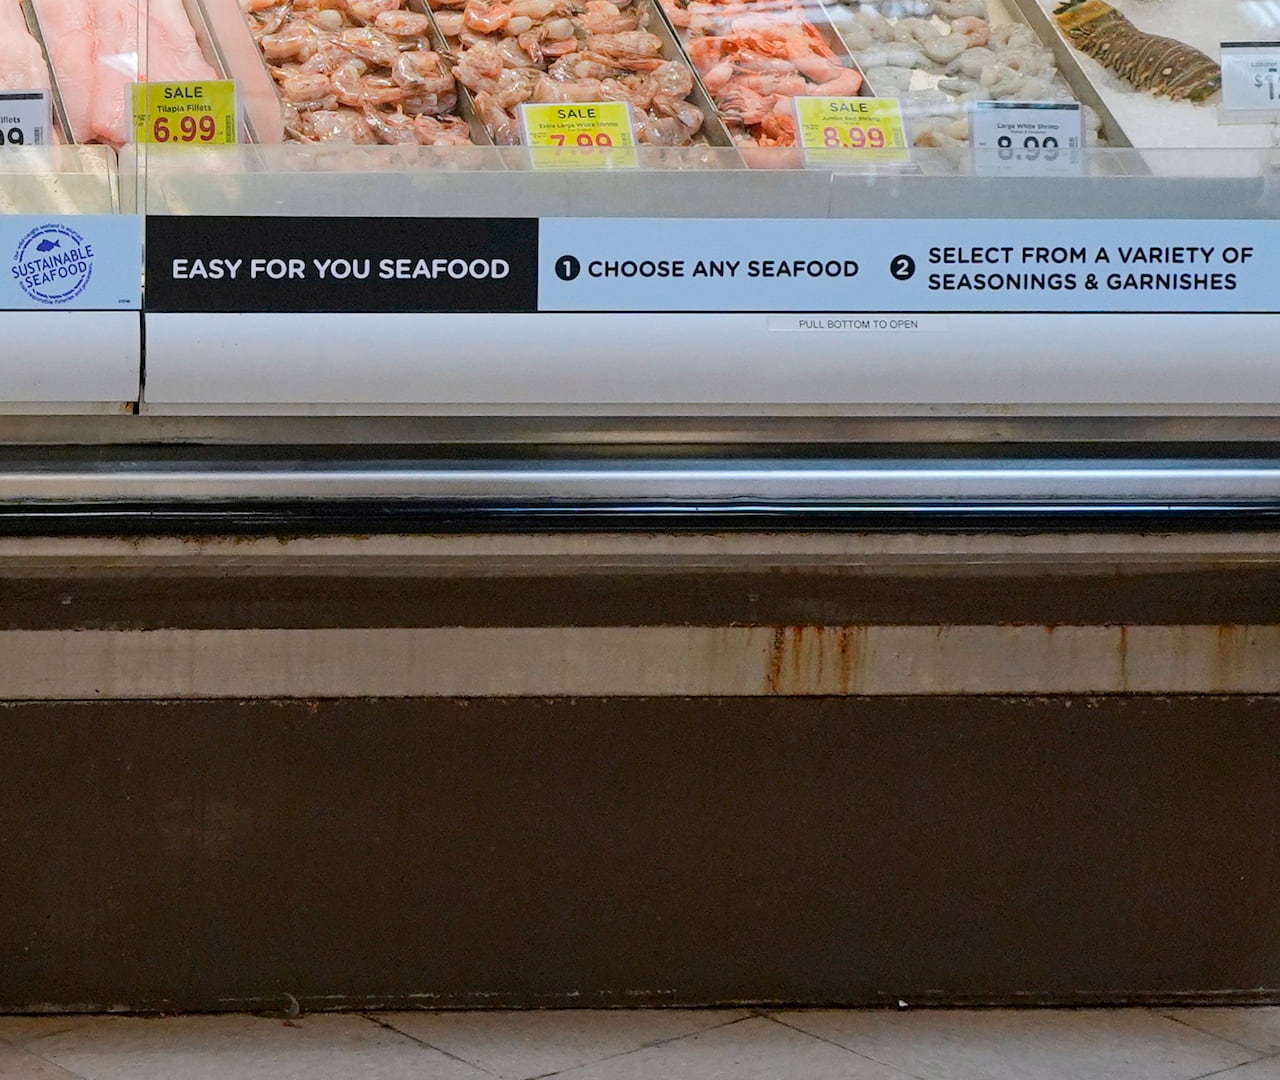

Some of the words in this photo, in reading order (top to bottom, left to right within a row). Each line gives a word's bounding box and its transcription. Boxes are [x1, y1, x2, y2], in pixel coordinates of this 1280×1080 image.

[164, 86, 204, 99] SALE
[156, 105, 185, 113] Tilapia
[186, 104, 212, 112] Fillets
[557, 108, 597, 119] SALE
[830, 102, 869, 113] SALE
[153, 115, 216, 143] 6.99
[1037, 123, 1060, 131] Shrimp
[823, 126, 885, 149] 8.99
[11, 244, 95, 279] SUSTAINABLE
[927, 246, 1014, 264] SELECT
[1021, 246, 1087, 264] FROM
[1094, 246, 1110, 264] A
[1117, 246, 1215, 264] VARIETY
[1221, 246, 1254, 264] OF
[24, 261, 88, 289] SEAFOOD
[172, 258, 243, 279] EASY
[250, 258, 306, 279] FOR
[313, 258, 371, 279] YOU
[377, 258, 510, 279] SEAFOOD
[588, 260, 685, 278] CHOOSE
[692, 260, 741, 278] ANY
[747, 260, 860, 278] SEAFOOD
[927, 273, 1077, 290] SEASONINGS
[1084, 273, 1100, 290] &
[1106, 273, 1238, 290] GARNISHES
[799, 320, 825, 329] PULL
[826, 320, 871, 329] BOTTOM
[873, 320, 887, 329] TO
[889, 320, 919, 329] OPEN
